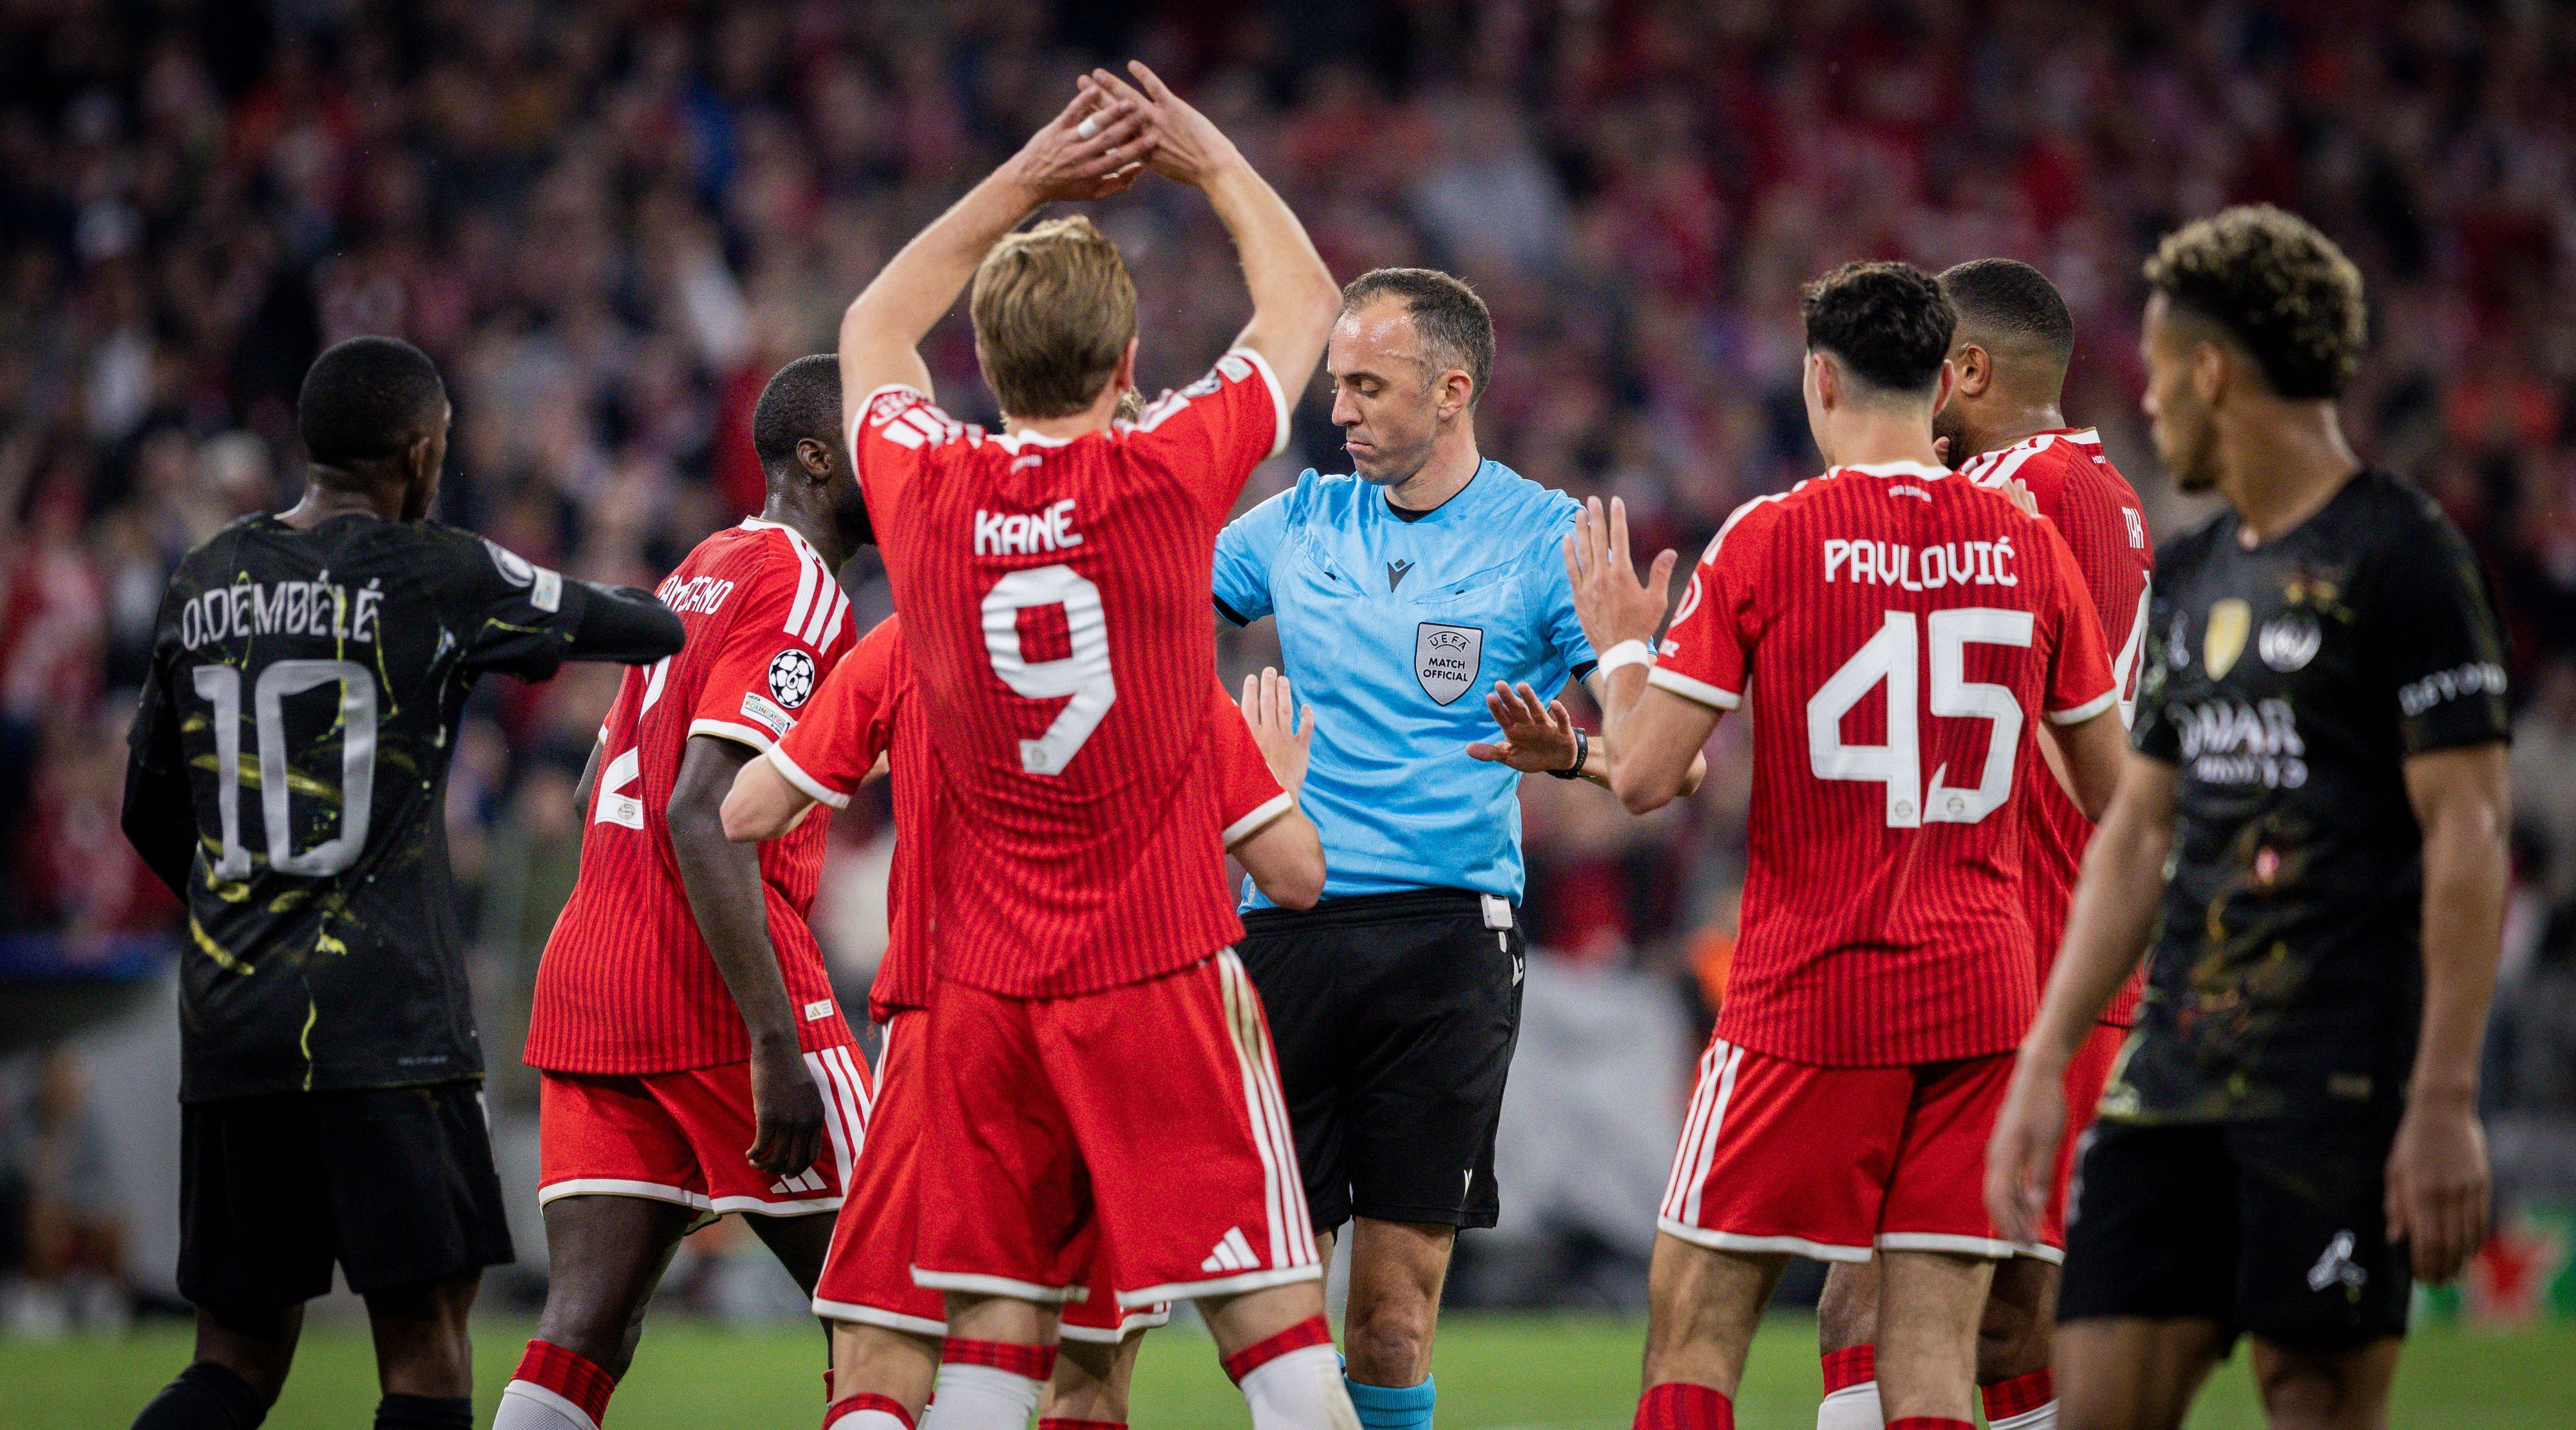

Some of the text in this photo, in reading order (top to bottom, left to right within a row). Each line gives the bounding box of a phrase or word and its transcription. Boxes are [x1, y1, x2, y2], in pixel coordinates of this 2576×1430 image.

[974, 498, 1083, 556] KANE
[2121, 506, 2145, 549] TAH
[1824, 535, 2018, 592] PAVLOVIĆ
[183, 569, 384, 651] O.DEMBÉLÉ
[1428, 657, 1465, 669] MATCH
[1430, 634, 1466, 651] UEFA
[786, 667, 800, 690] 6
[981, 564, 1117, 776] 9
[1423, 669, 1468, 682] OFFICIAL
[745, 700, 786, 729] FOUNDATION
[748, 694, 761, 702] UEFA
[1806, 607, 2034, 828] 45
[193, 658, 377, 881] 10
